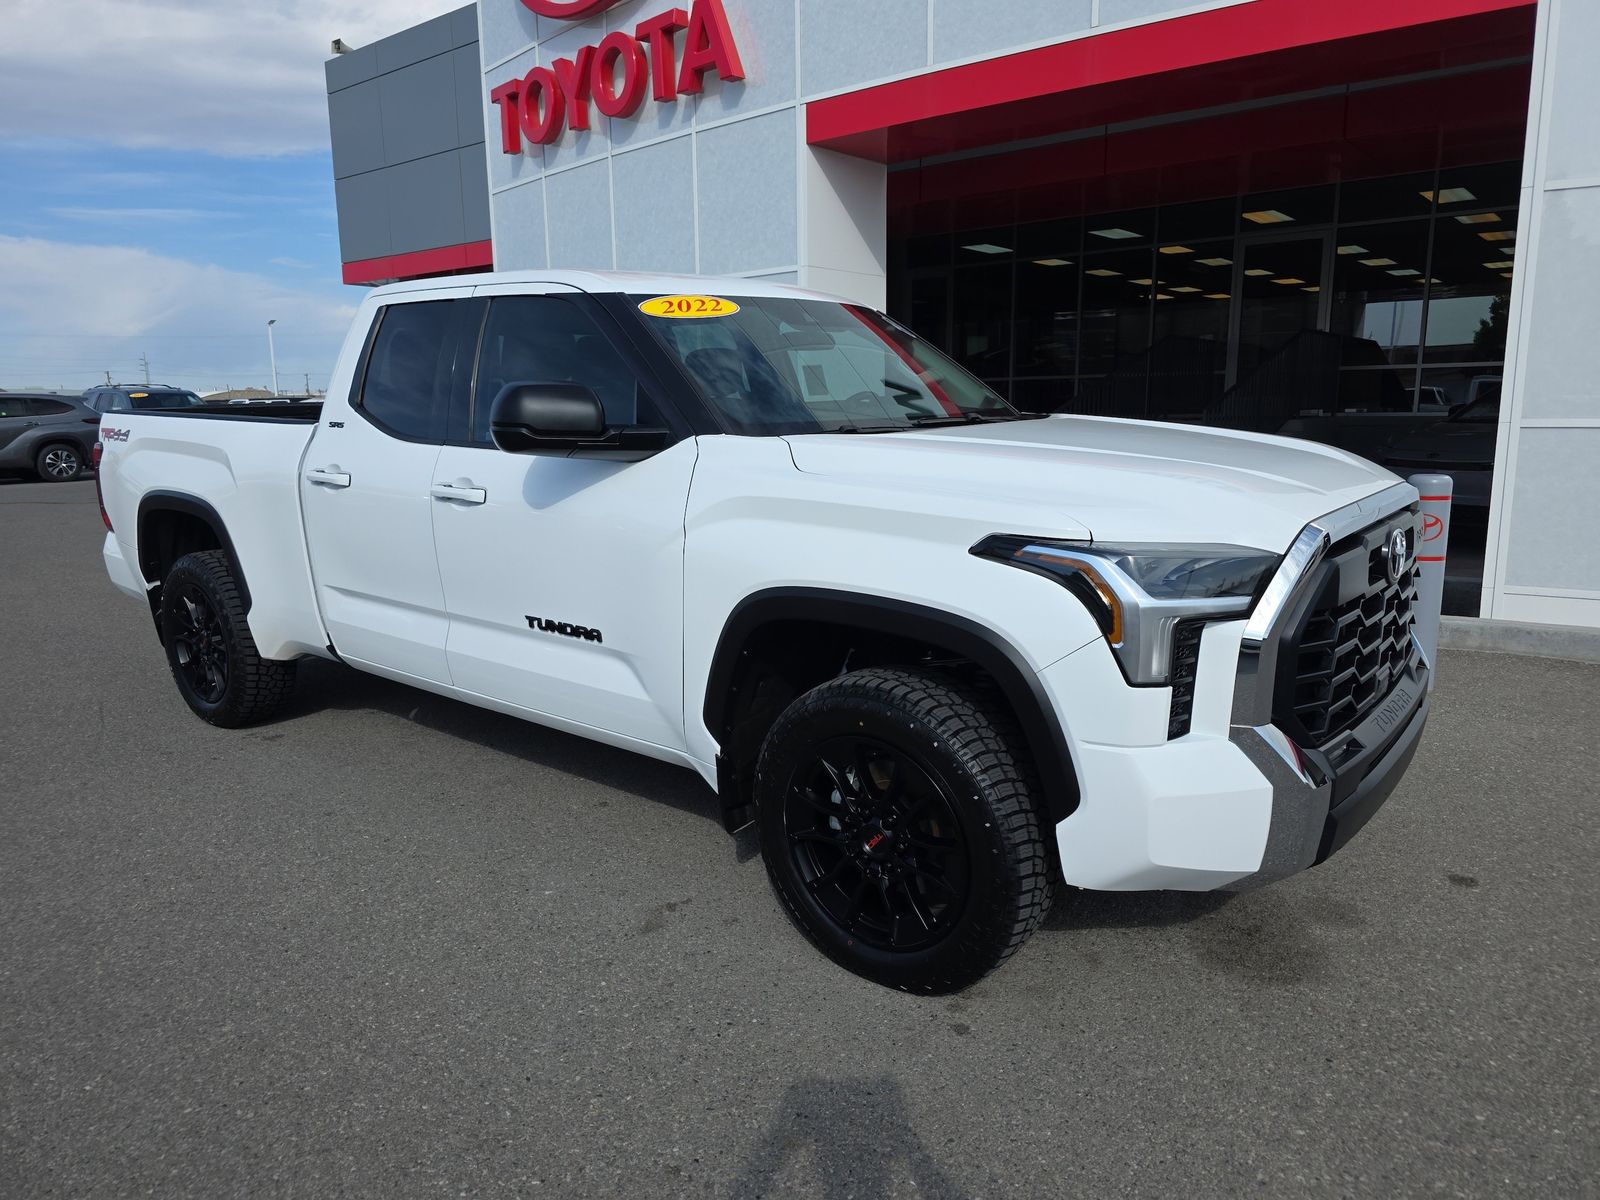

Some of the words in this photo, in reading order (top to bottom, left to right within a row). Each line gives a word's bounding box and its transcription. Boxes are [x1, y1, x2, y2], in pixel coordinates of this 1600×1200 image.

[491, 0, 745, 155] TOYOTA
[661, 299, 722, 313] 2022
[525, 615, 603, 643] TUNDRA
[1371, 688, 1412, 733] TUNDRA
